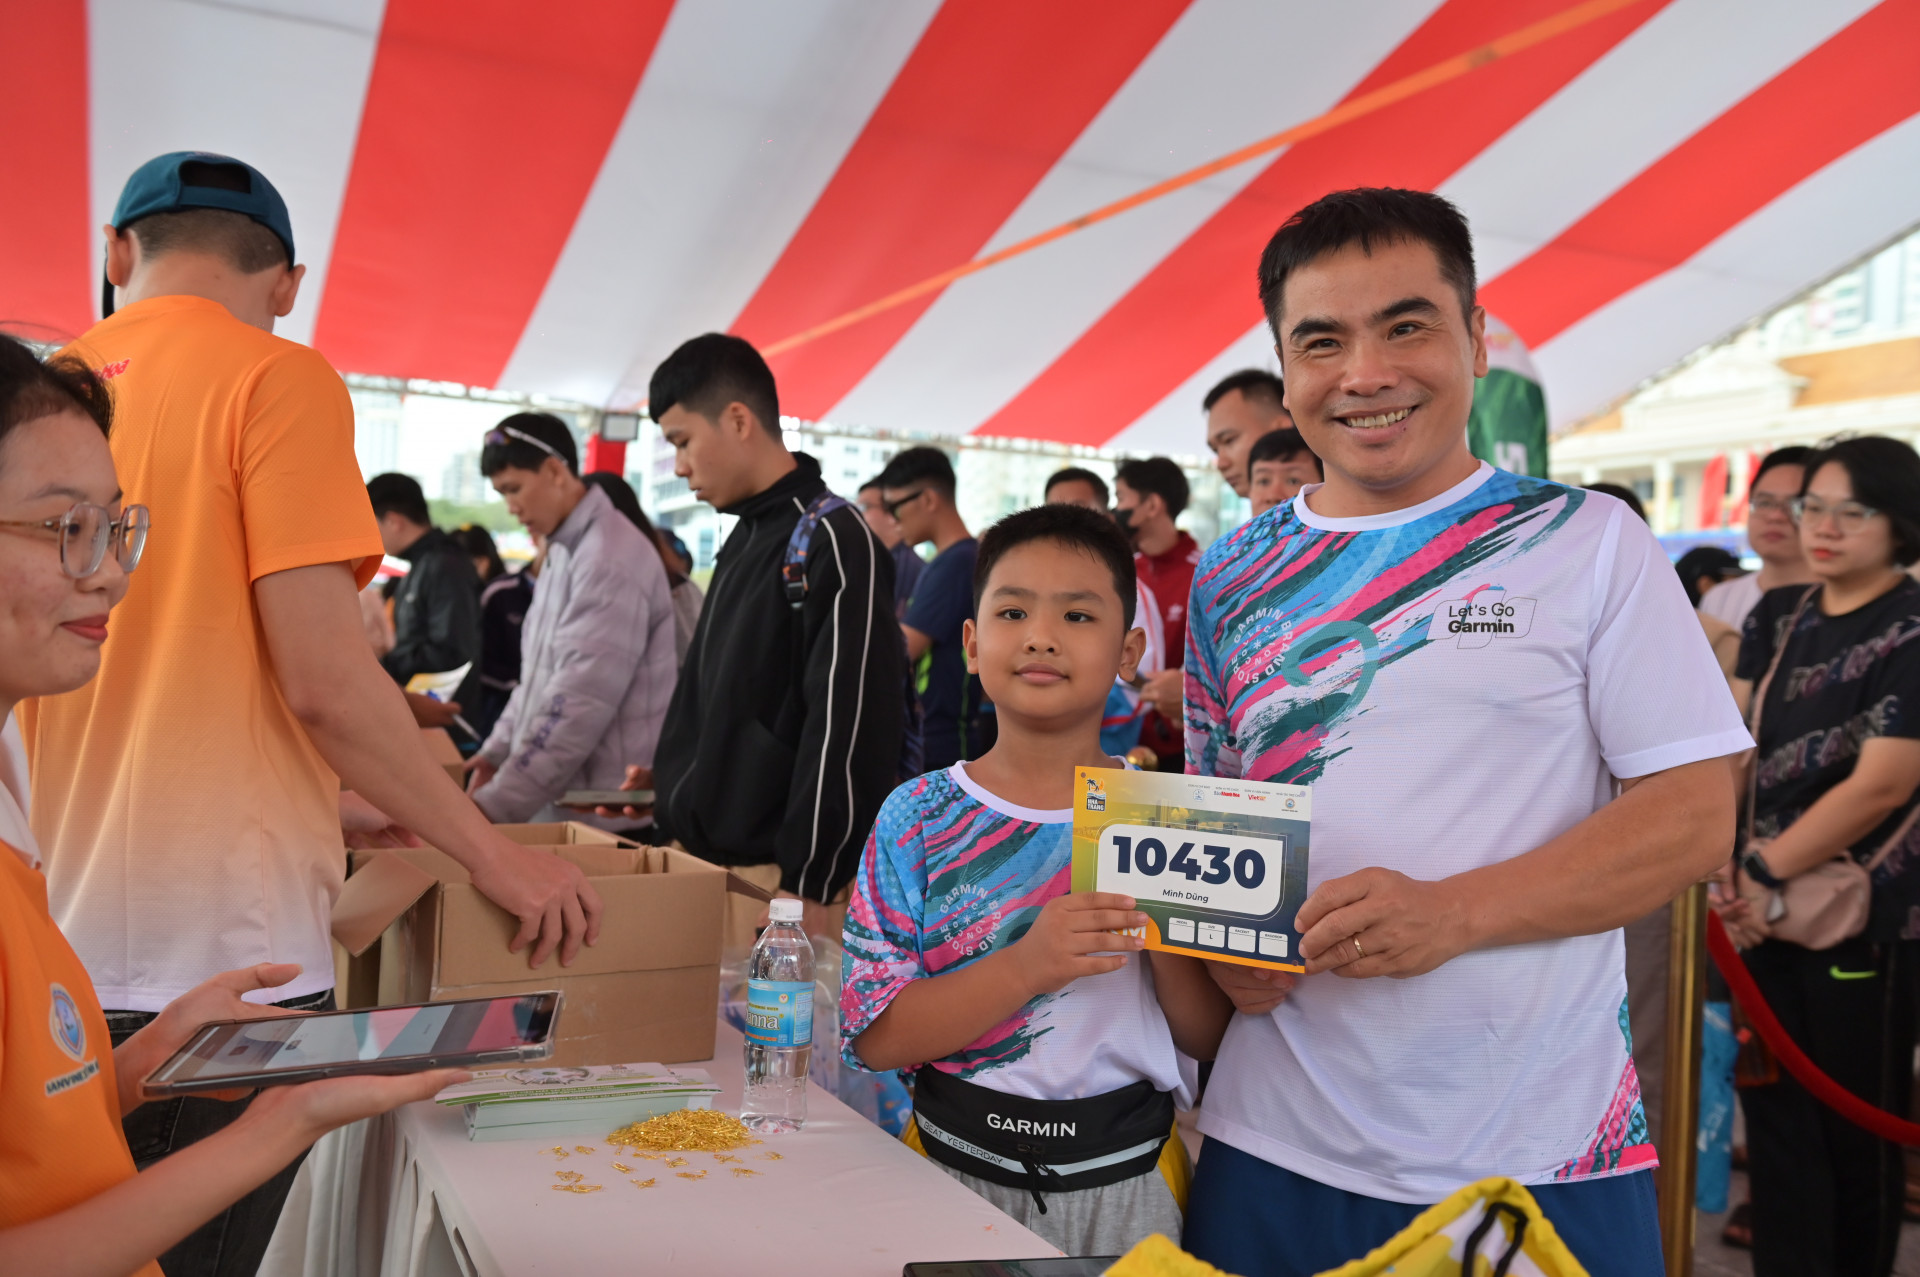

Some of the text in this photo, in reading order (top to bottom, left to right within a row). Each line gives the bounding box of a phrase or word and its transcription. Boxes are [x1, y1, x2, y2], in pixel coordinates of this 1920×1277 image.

[1448, 602, 1515, 617] Let's Go
[1448, 618, 1514, 633] Garmin
[1231, 607, 1294, 685] GARMIN BRAND STORE
[1241, 624, 1276, 666] COLLECTION
[1112, 835, 1266, 889] 10430
[1162, 889, 1209, 904] Minh Dũng
[940, 883, 1002, 956] GARMIN BRAND STORE
[952, 901, 986, 940] COLLECTION
[923, 1121, 1003, 1165] BEAT YESTERDAY
[986, 1113, 1076, 1137] GARMIN
